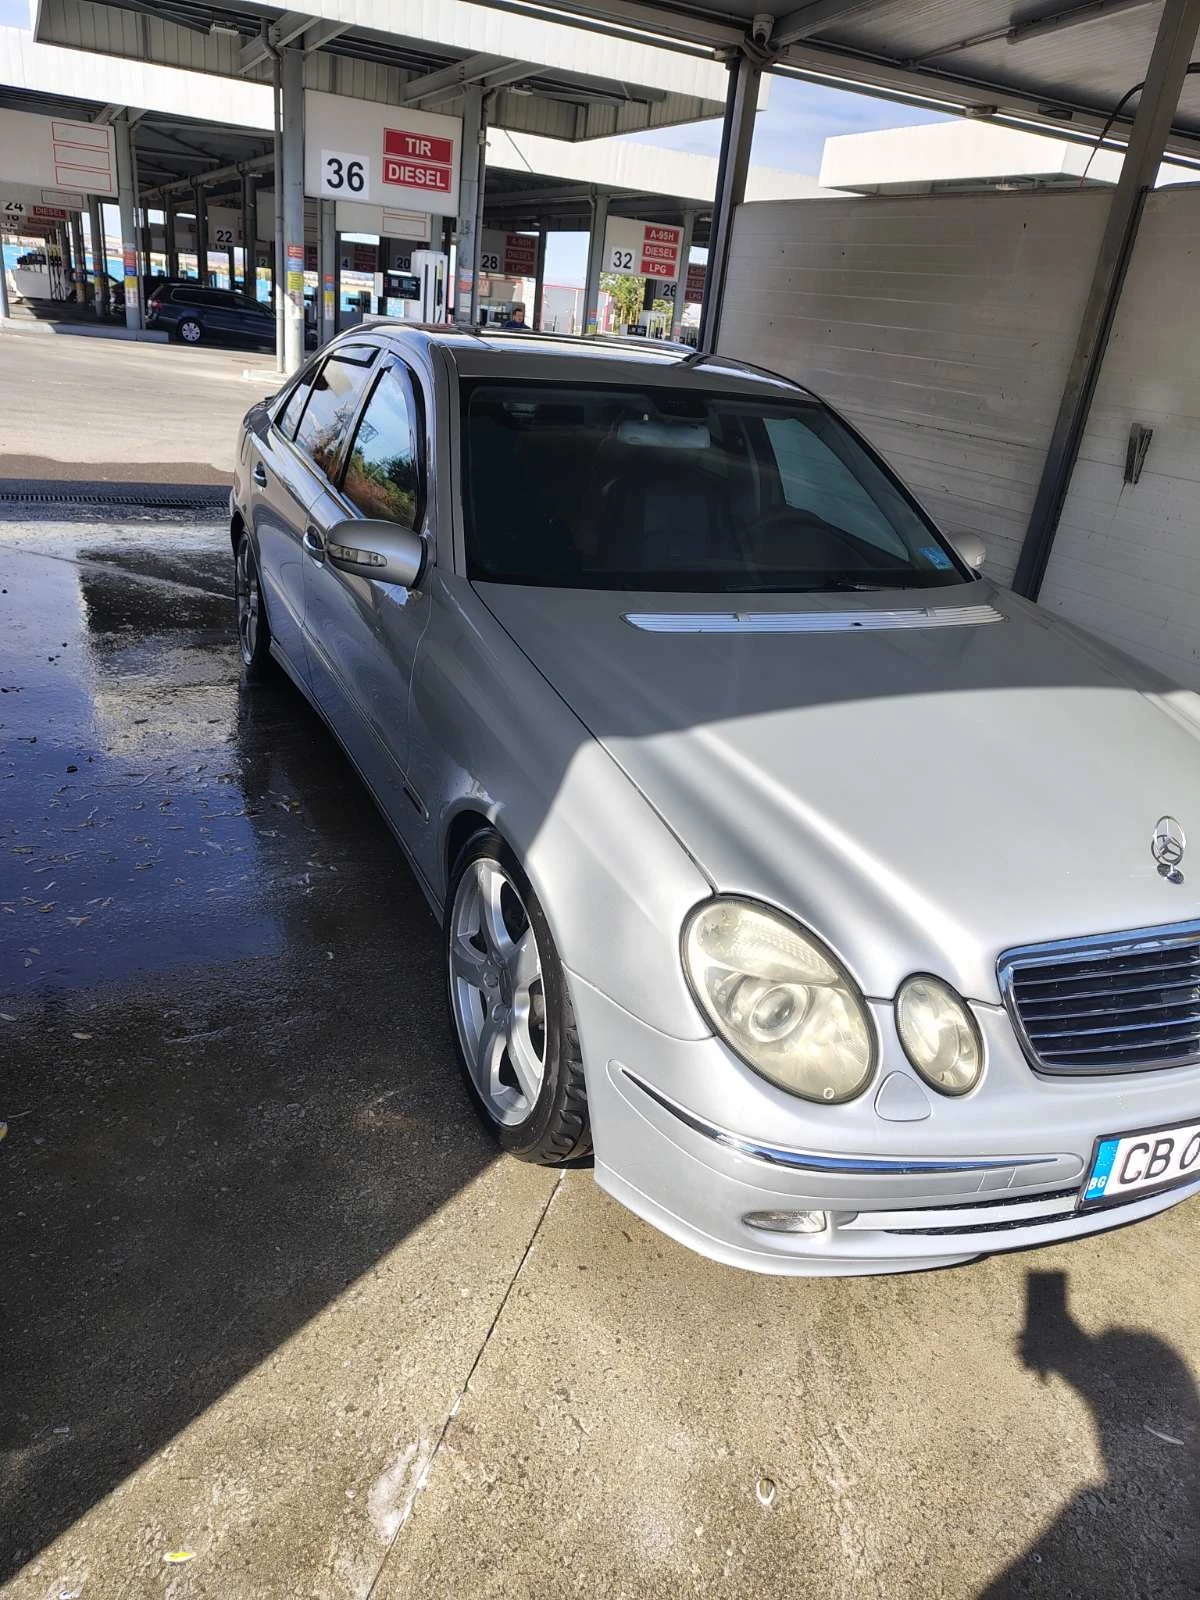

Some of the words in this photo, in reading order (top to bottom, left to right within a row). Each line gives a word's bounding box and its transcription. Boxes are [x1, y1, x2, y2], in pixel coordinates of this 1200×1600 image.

[405, 137, 432, 157] TIR
[326, 158, 364, 192] 36
[388, 164, 445, 187] DIESEL
[216, 230, 233, 243] 22
[644, 246, 674, 258] DIESEL
[396, 257, 411, 270] 20
[481, 254, 498, 270] 28
[613, 251, 633, 270] 32
[649, 263, 667, 274] LPG
[663, 284, 677, 297] 26
[1119, 1137, 1175, 1185] CB
[1088, 1175, 1107, 1191] BG
